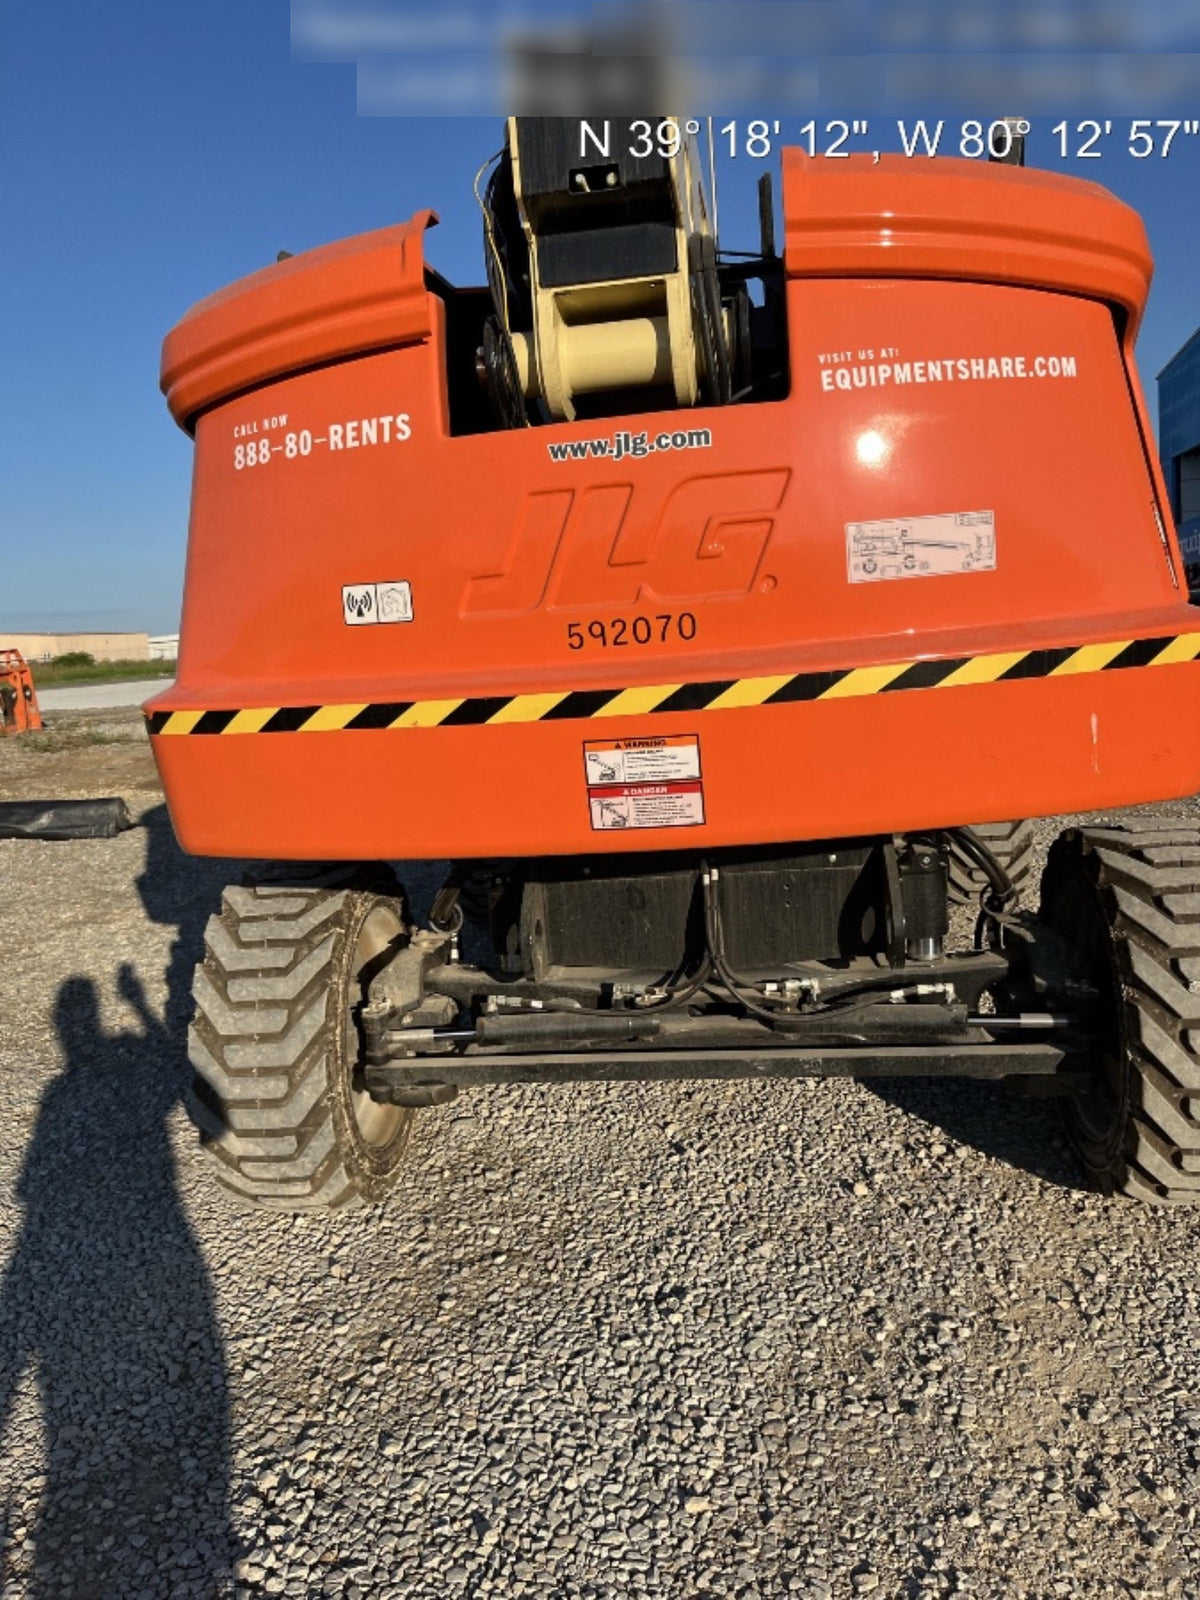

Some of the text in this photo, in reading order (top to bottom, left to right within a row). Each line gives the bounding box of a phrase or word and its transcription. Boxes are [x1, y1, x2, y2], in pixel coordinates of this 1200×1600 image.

[818, 347, 900, 364] VISIT US AT:
[820, 356, 1077, 392] EQUIPMENTSHARE.COM
[233, 414, 288, 438] CALL NOW
[233, 413, 411, 470] 888-80-RENTS
[549, 428, 711, 462] www.jlg.com
[567, 612, 697, 650] 592070
[623, 739, 667, 749] WARNING
[630, 786, 667, 796] DANGER
